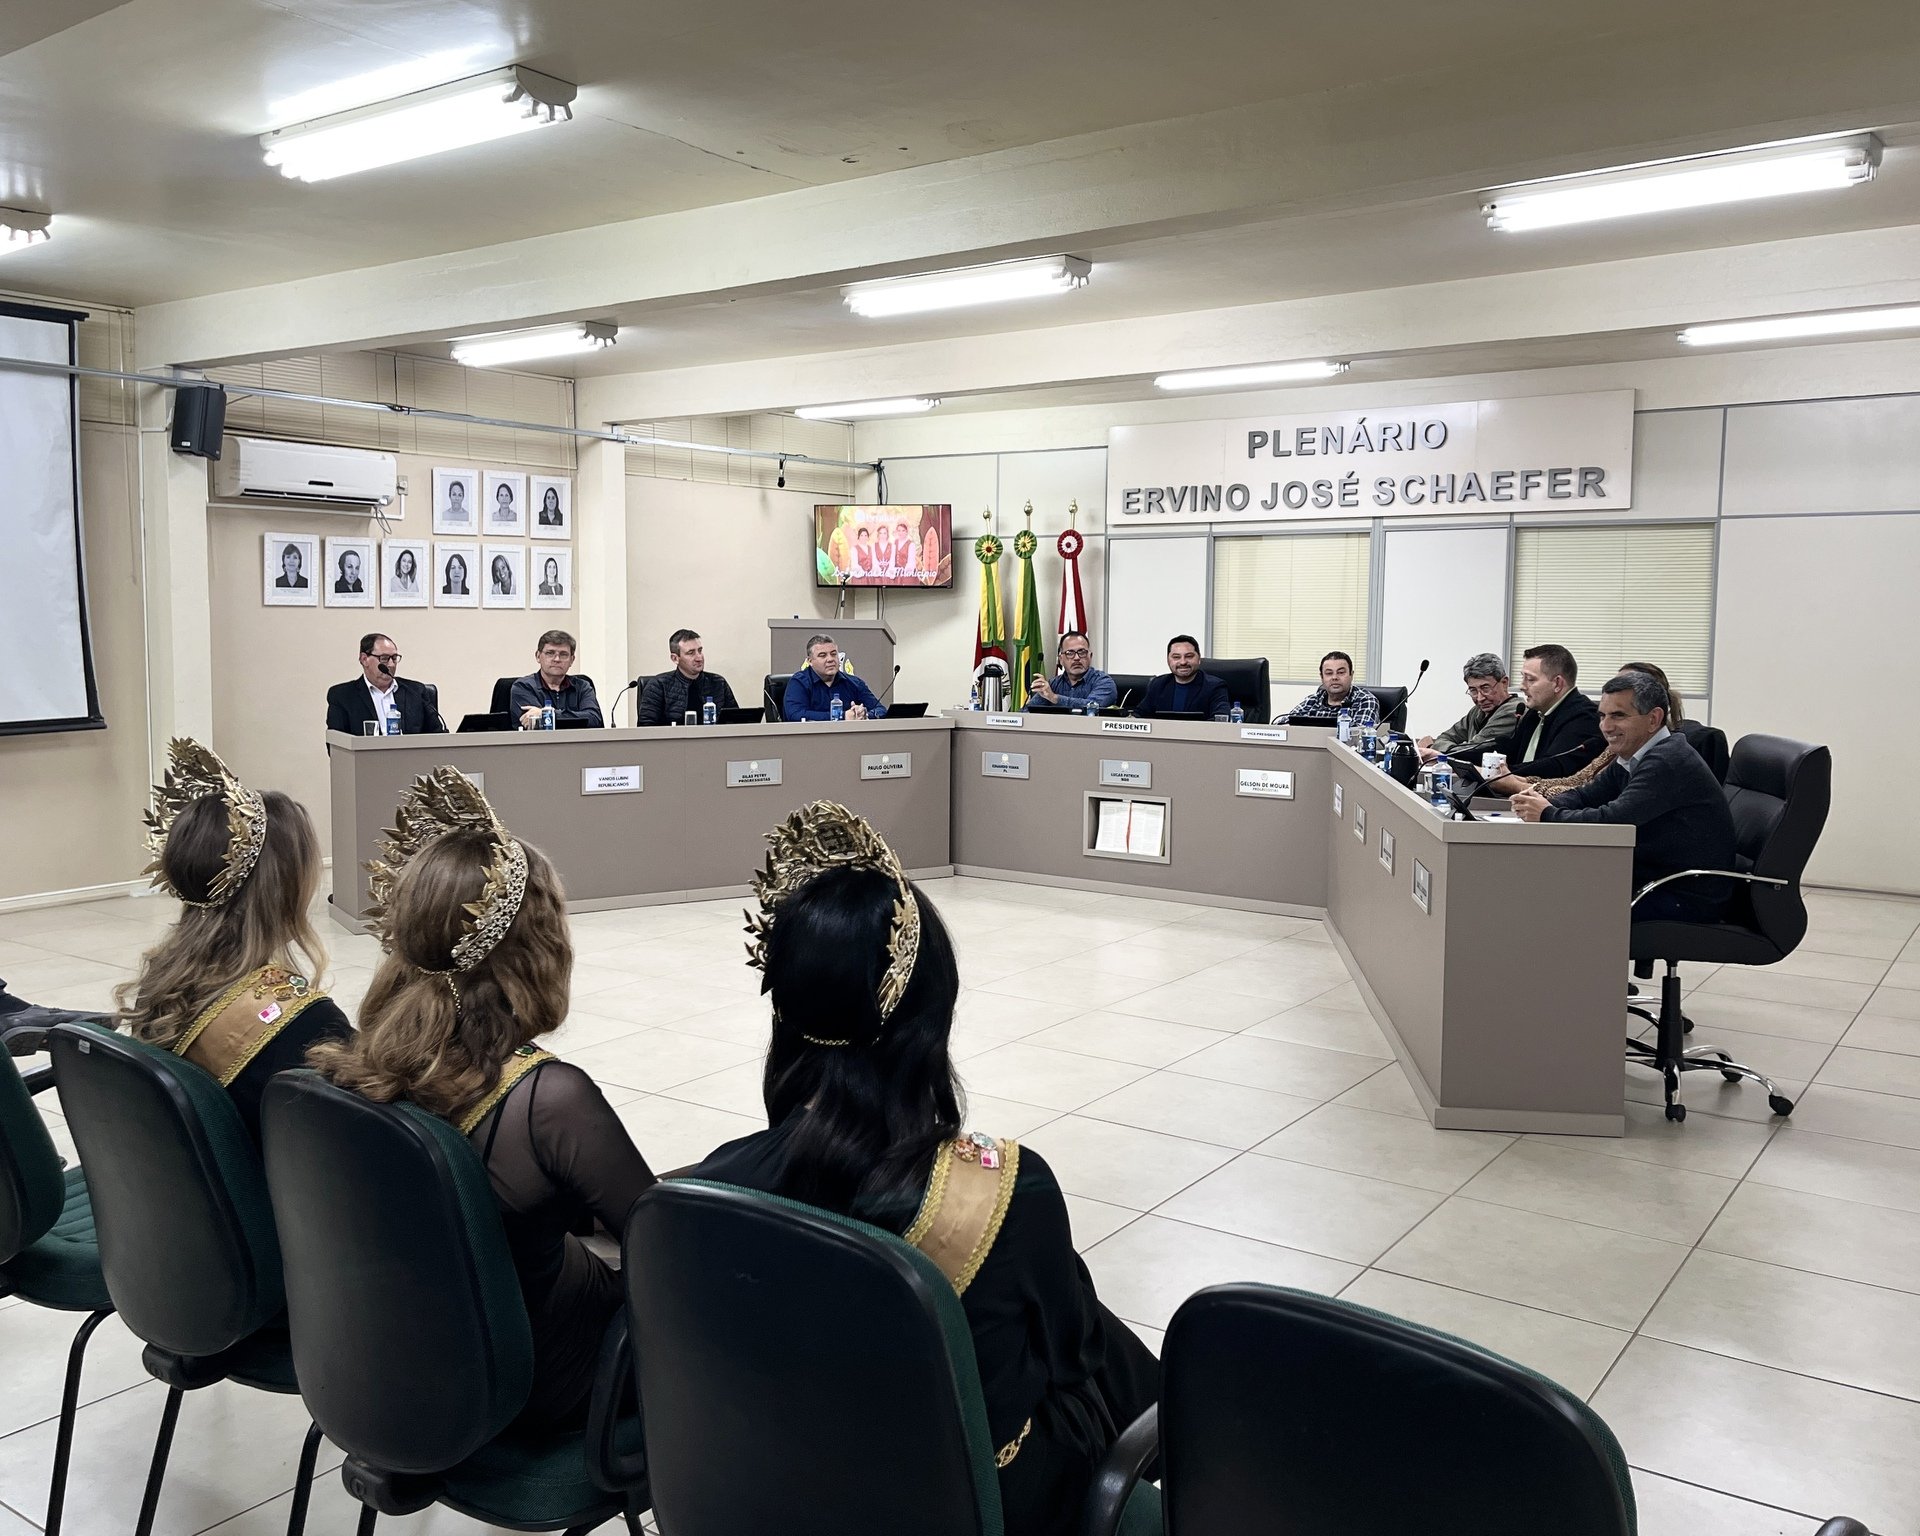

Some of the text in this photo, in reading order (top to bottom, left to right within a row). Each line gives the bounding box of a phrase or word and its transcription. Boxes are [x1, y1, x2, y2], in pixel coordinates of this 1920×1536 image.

[1247, 417, 1449, 459] PLENÁRIO
[1122, 465, 1608, 515] ERVINO JOSÉ SCHAEFER
[1104, 722, 1148, 731] PRESIDENTE
